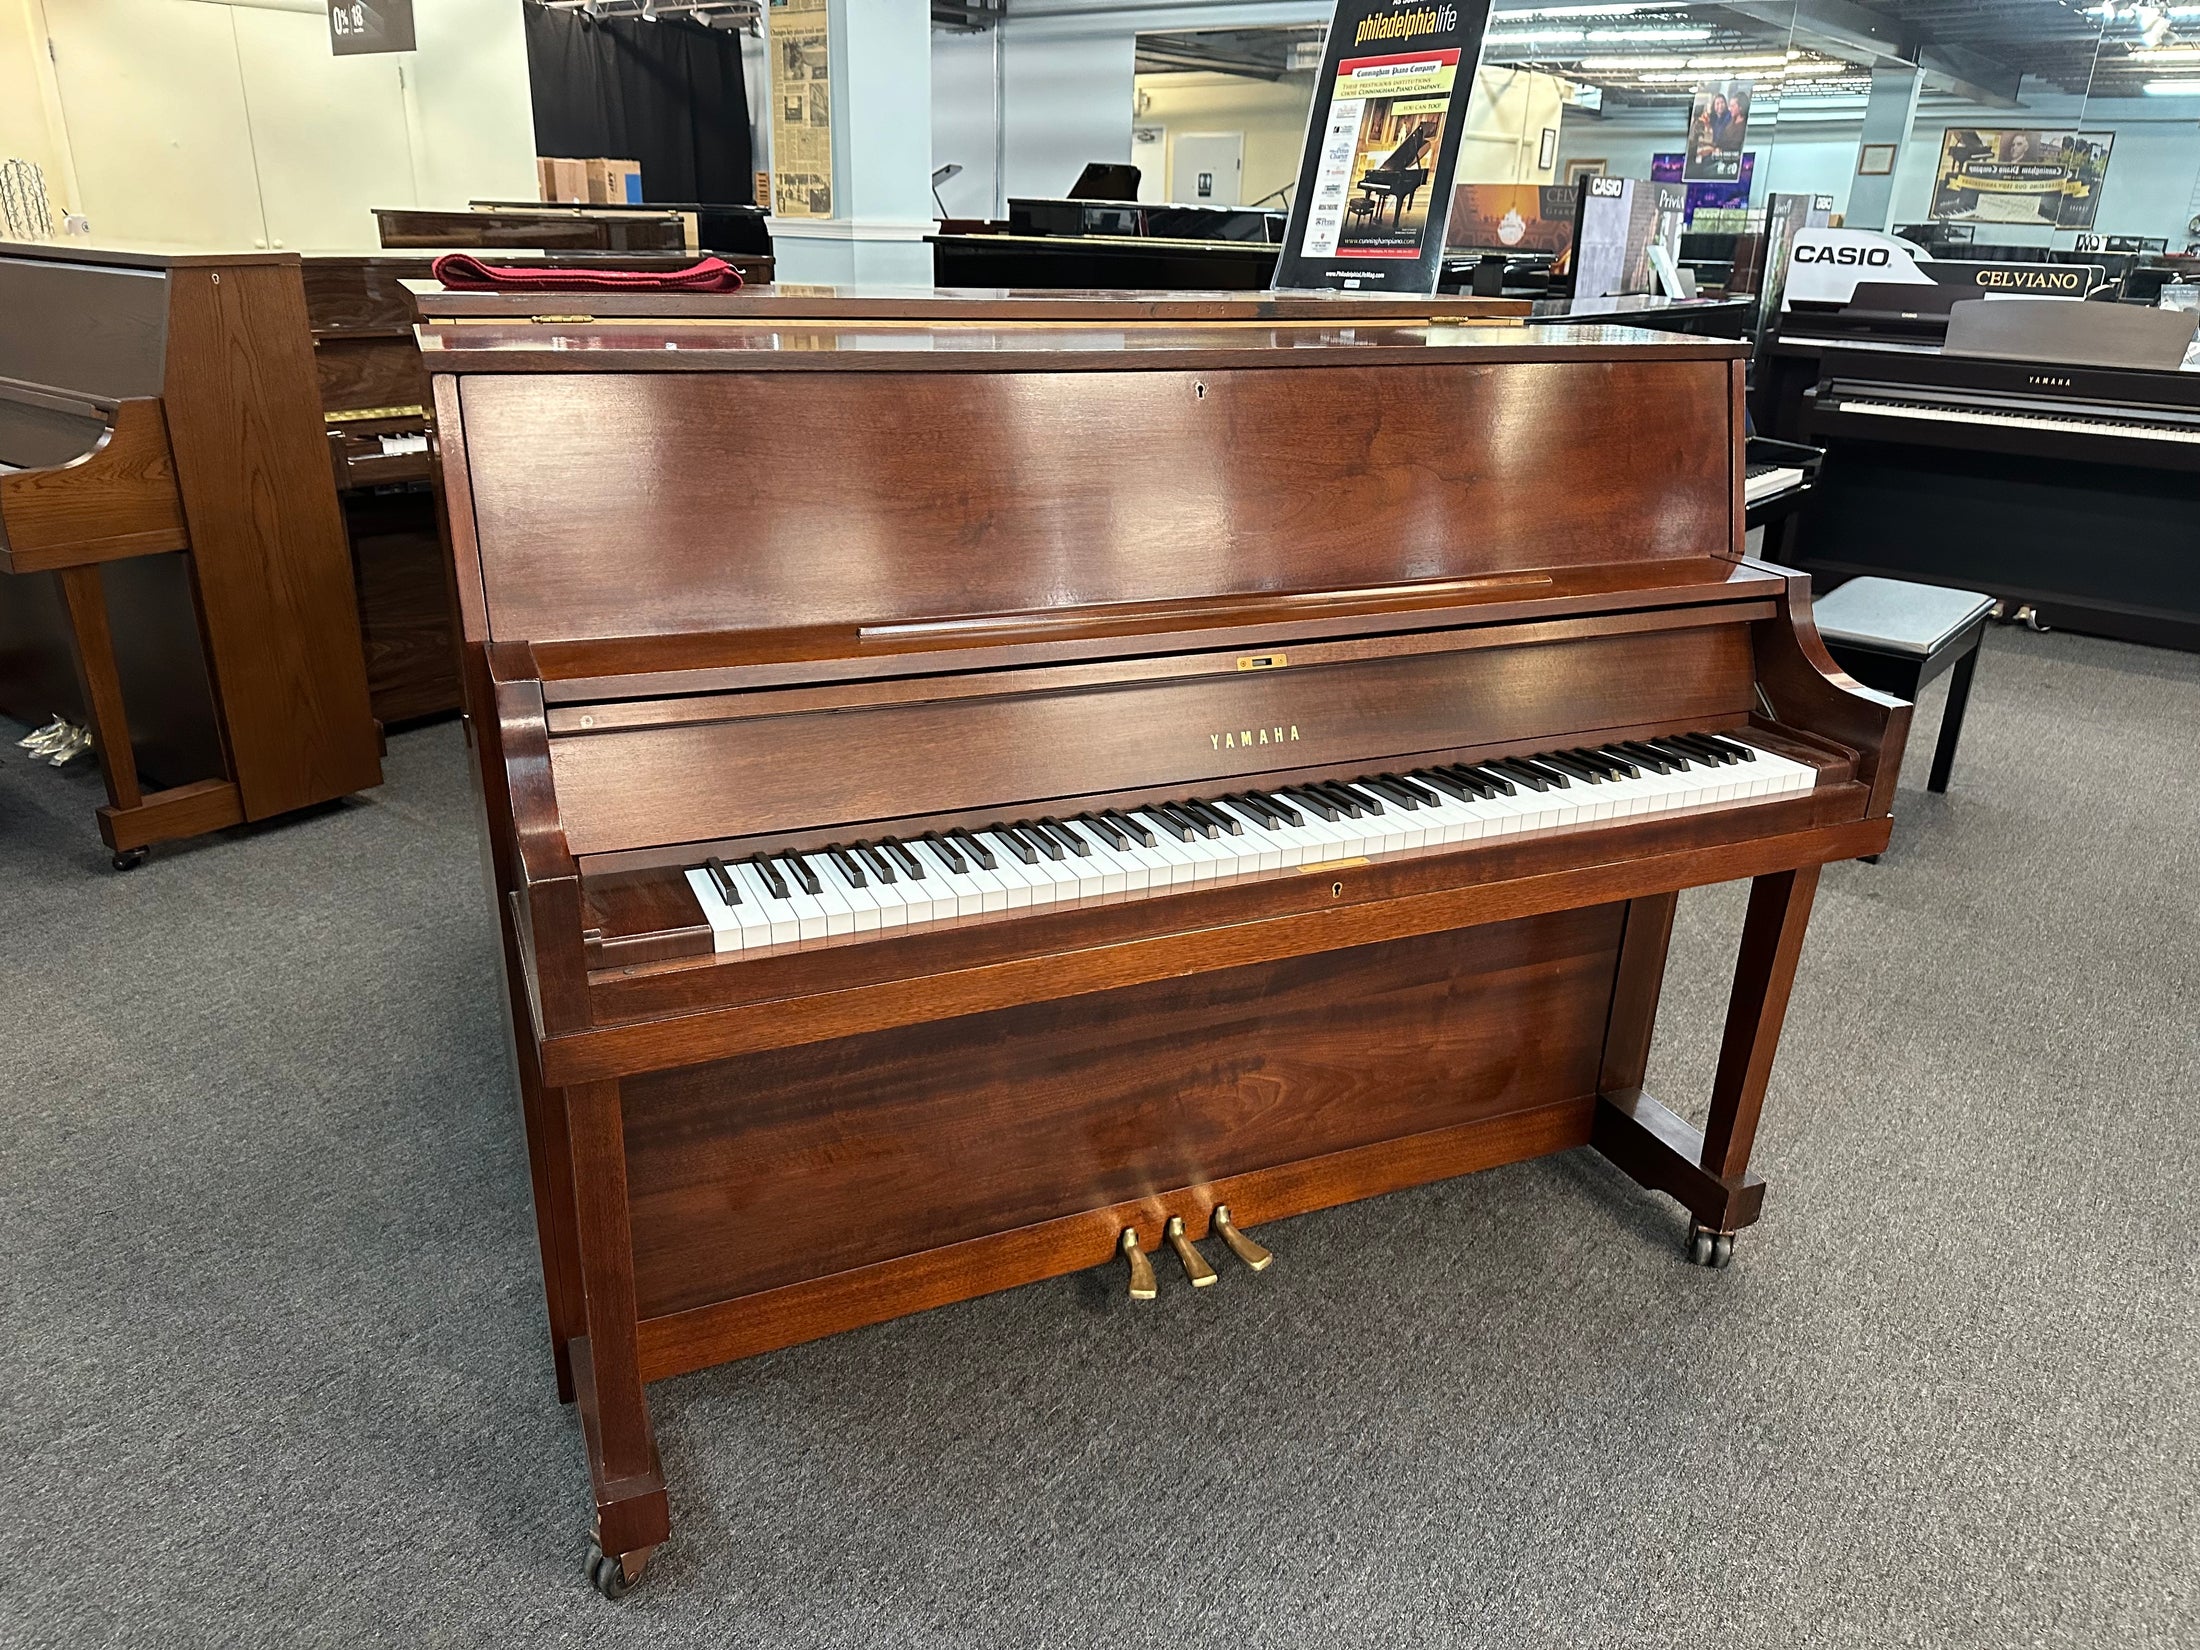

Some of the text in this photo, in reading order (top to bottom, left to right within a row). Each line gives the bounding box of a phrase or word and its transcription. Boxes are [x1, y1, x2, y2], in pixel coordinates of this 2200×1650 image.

[333, 4, 363, 35] 0% 18
[1354, 4, 1457, 47] philadelphialife
[1357, 64, 1436, 78] Cunningham Piano Company
[1592, 178, 1622, 197] CASIO
[1794, 245, 1890, 267] CASIO
[1975, 270, 2078, 289] CELVIANO
[2029, 375, 2071, 387] YAMAHA
[1209, 725, 1300, 751] YAMAHA
